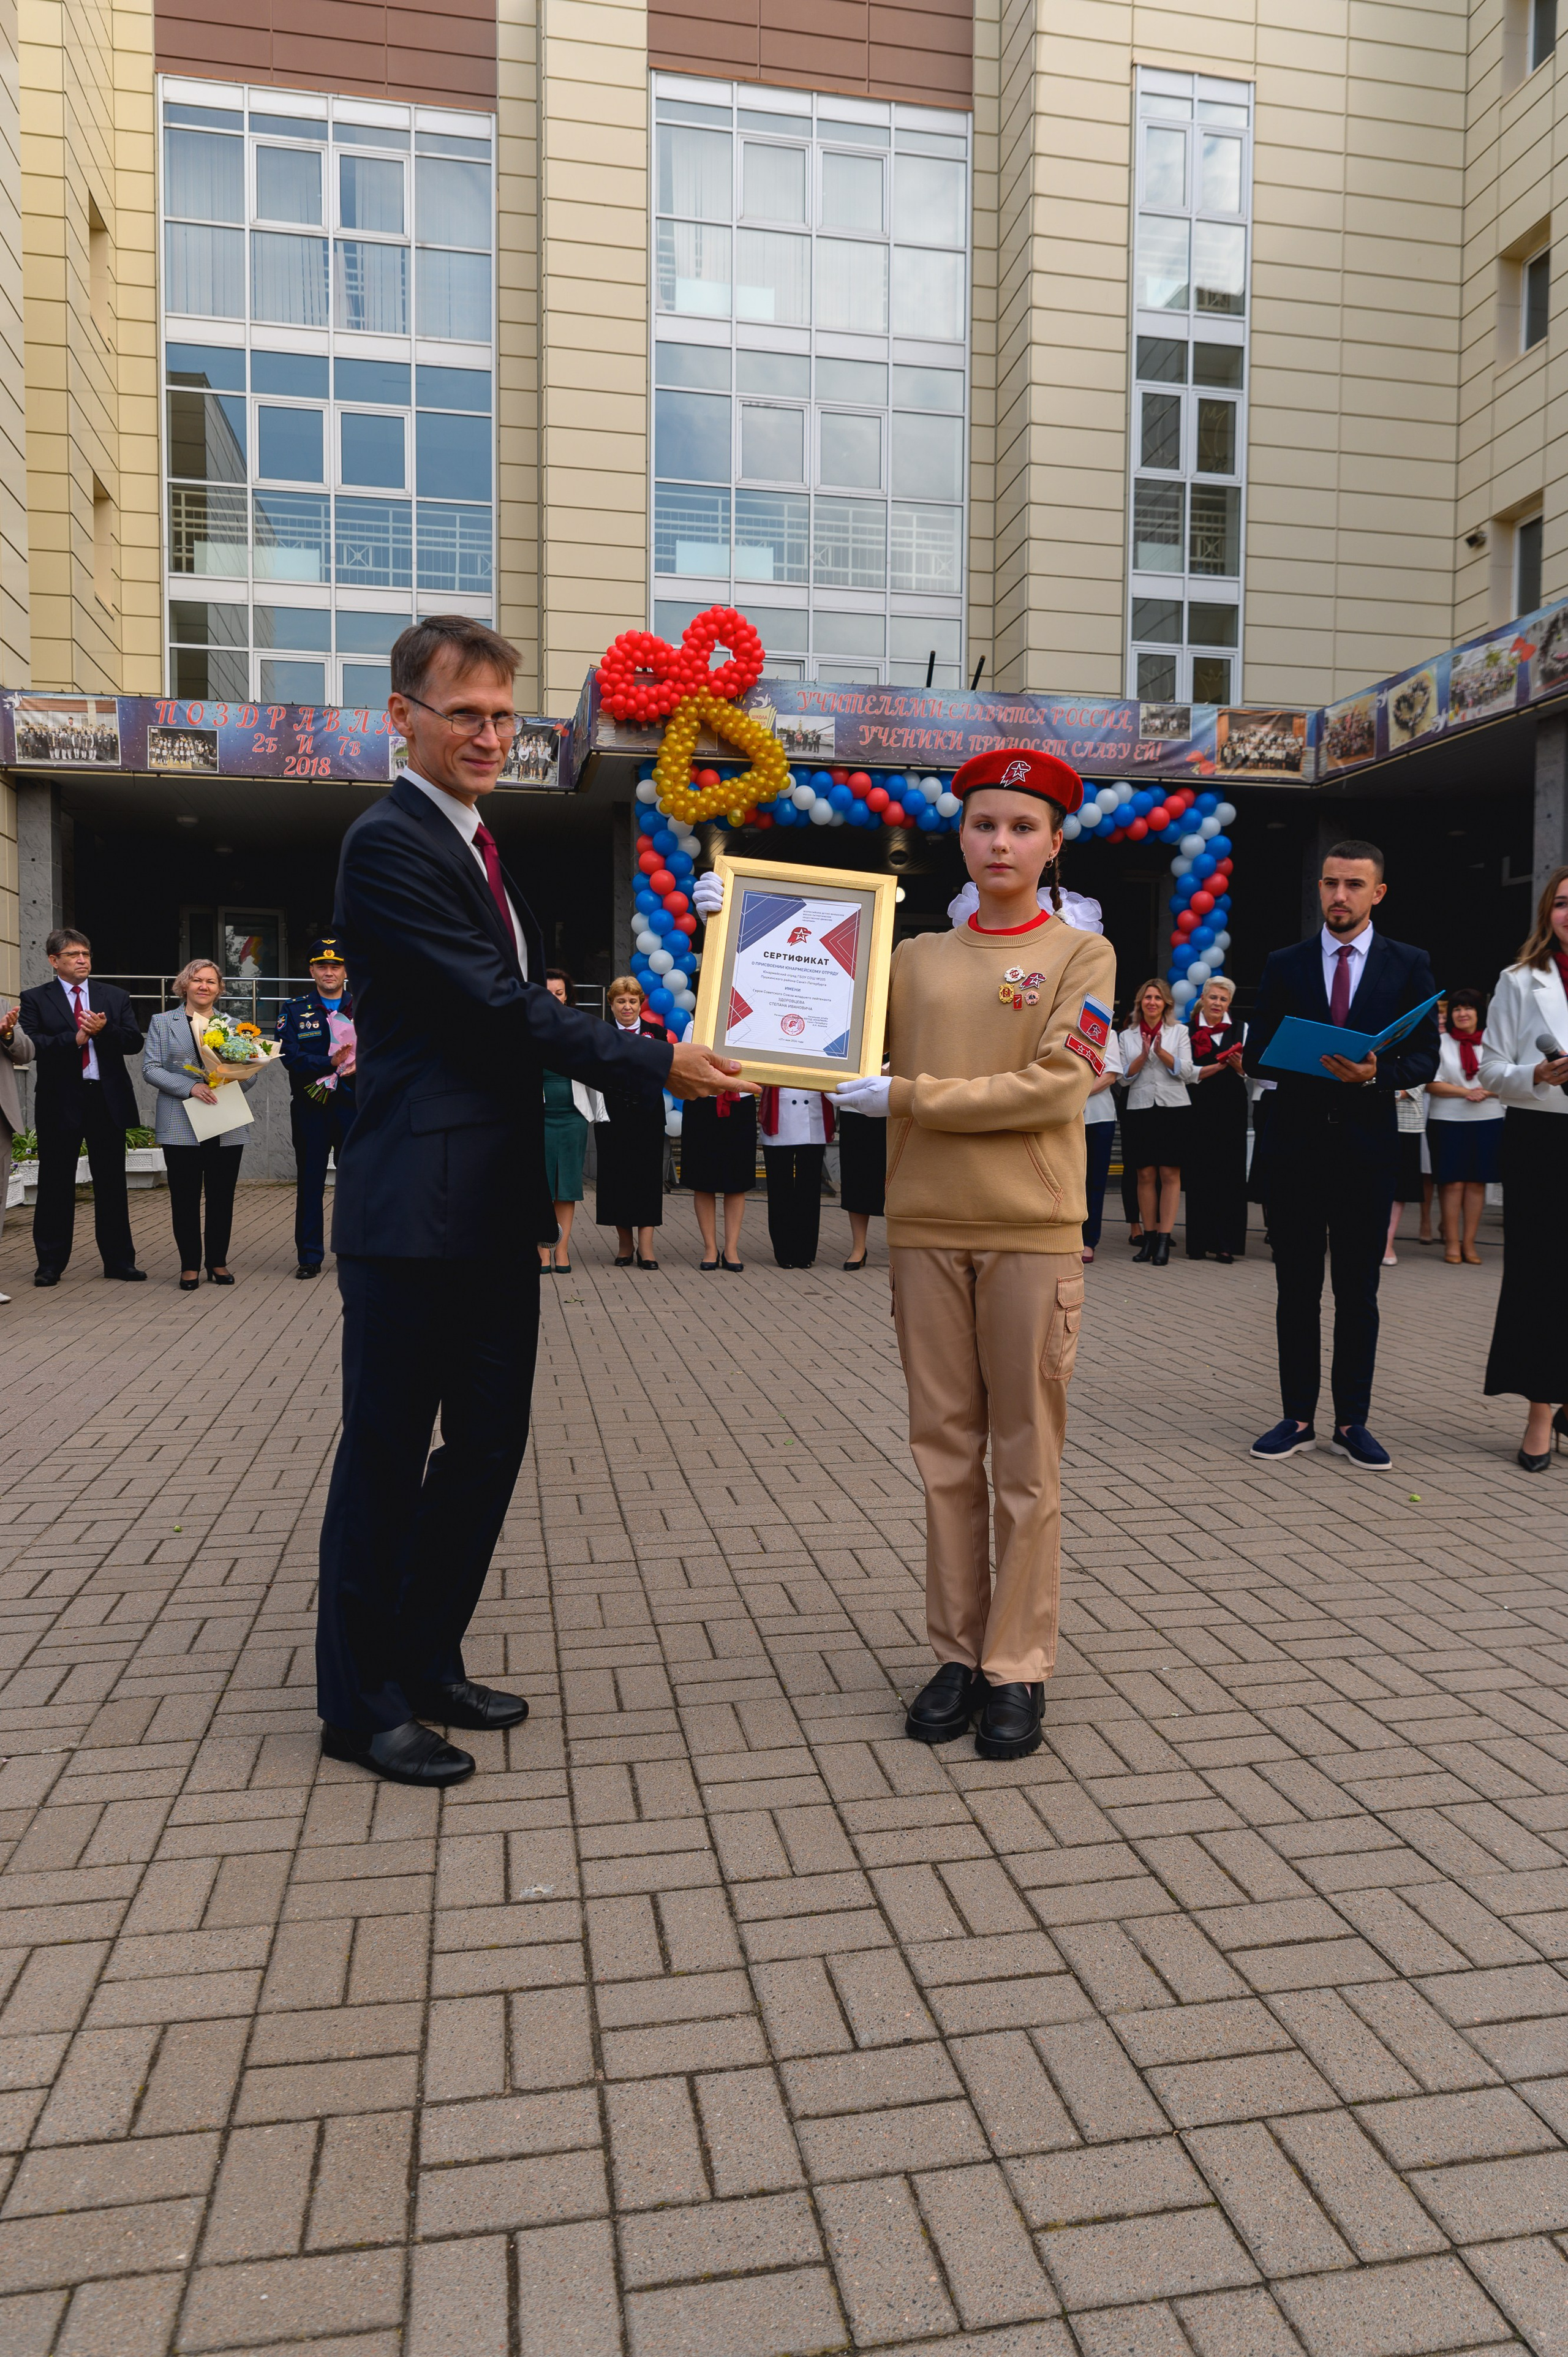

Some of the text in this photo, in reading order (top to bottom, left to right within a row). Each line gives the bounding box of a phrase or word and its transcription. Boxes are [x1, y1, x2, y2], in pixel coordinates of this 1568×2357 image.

[797, 691, 1133, 732] УЧИТЕЛЯМИ СЛАВИТСЯ РОССИЯ,
[296, 735, 314, 754] И
[859, 725, 1163, 761] УЧЕНИКИ ПРИНОСЯТ СЛАВУ ЕЙ!
[284, 756, 331, 777] 2018
[763, 951, 829, 965] СЕРТИФИКАТ
